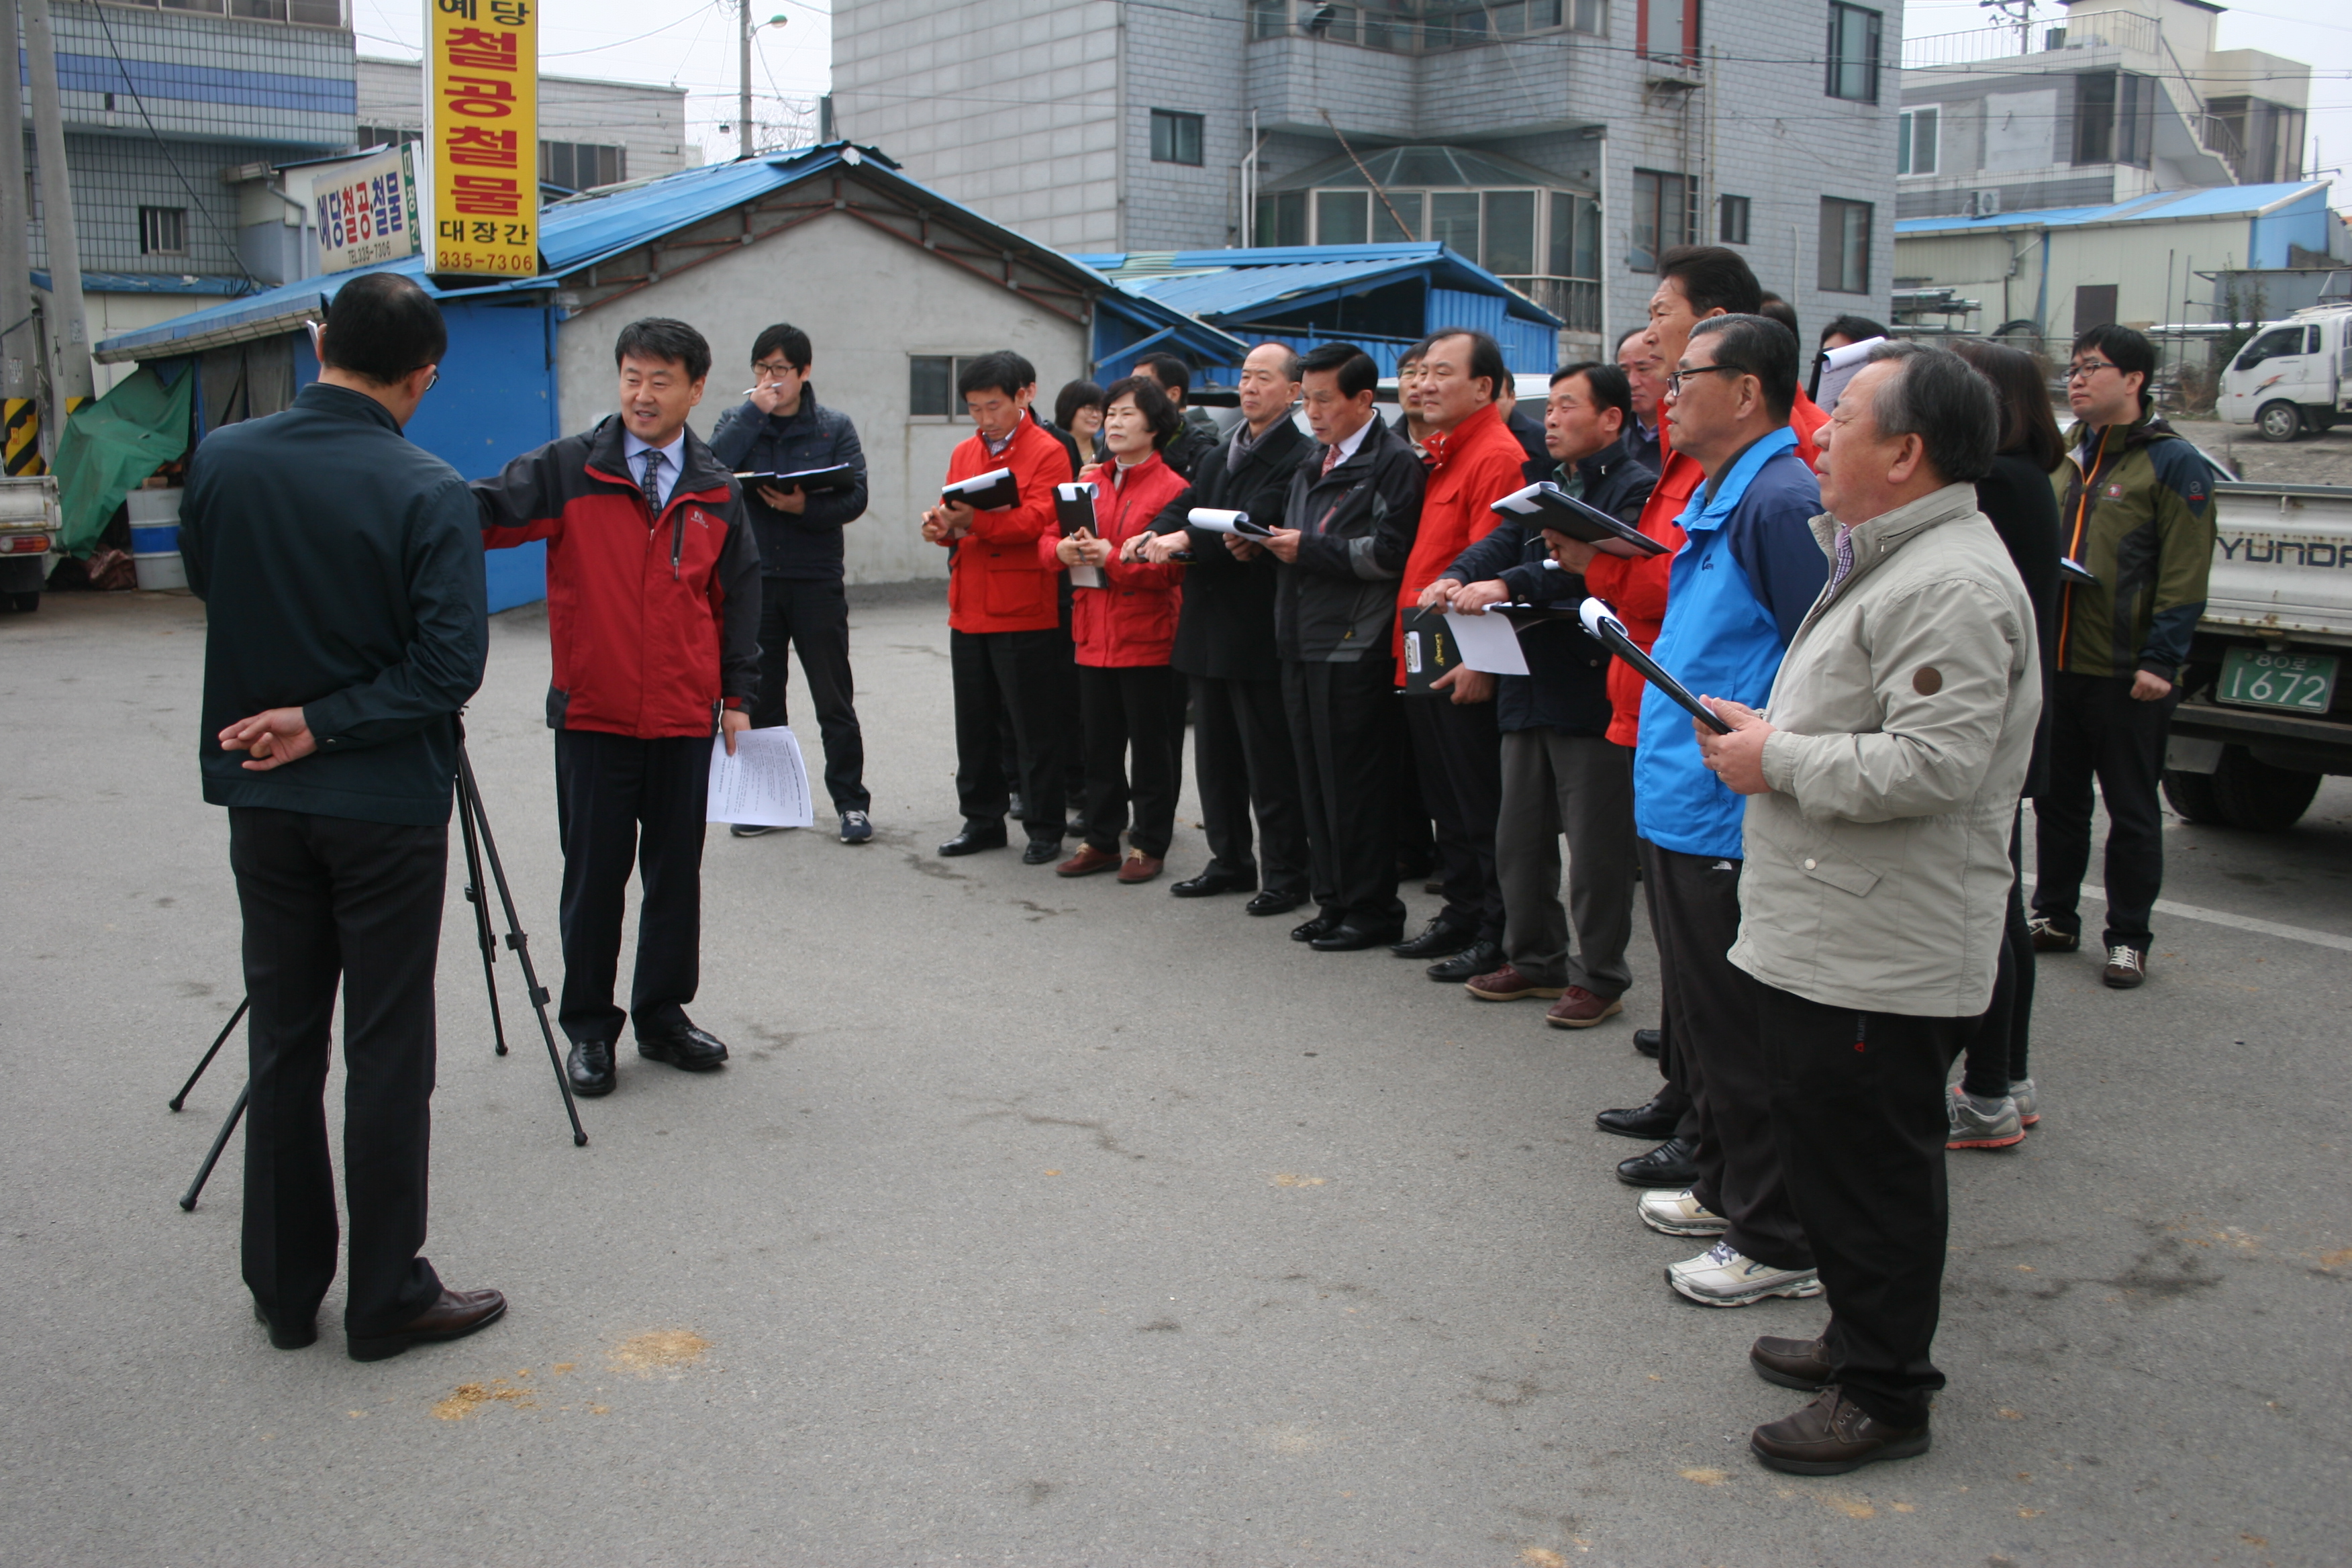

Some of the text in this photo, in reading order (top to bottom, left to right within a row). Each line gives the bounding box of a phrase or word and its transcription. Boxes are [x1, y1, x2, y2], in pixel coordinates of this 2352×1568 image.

[438, 0, 530, 26] 예당
[403, 150, 420, 246] 대장간
[440, 220, 529, 246] 대장간
[439, 251, 533, 271] 335-7306
[2232, 667, 2326, 707] 1672
